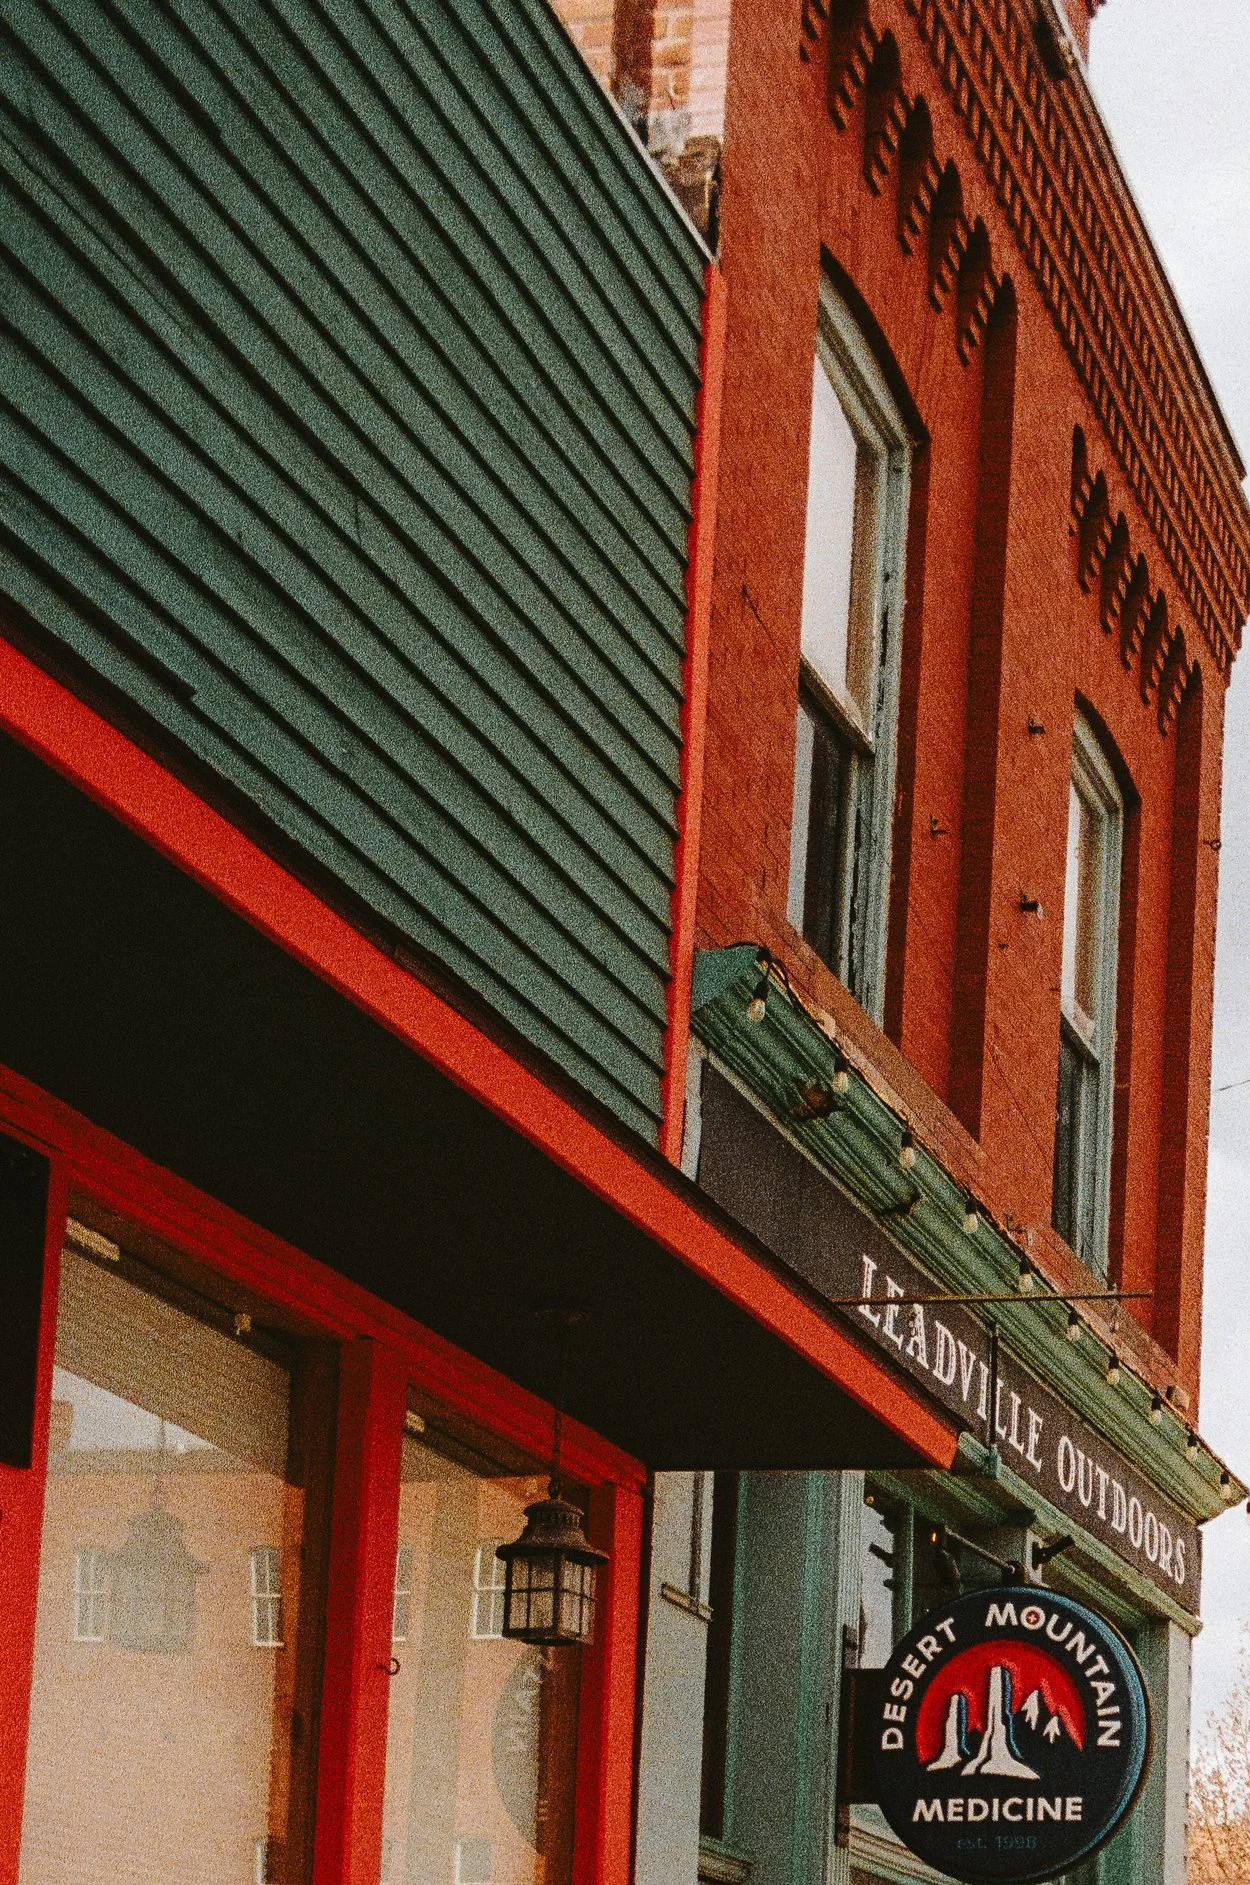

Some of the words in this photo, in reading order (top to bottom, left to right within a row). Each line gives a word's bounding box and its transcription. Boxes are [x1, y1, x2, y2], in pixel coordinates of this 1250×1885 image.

[859, 1254, 1043, 1472] LEADVILLE
[1057, 1436, 1186, 1585] OUTDOORS
[881, 1617, 957, 1750] DESERT
[985, 1602, 1122, 1747] MOUNTAIN
[912, 1797, 1083, 1822] MEDICINE
